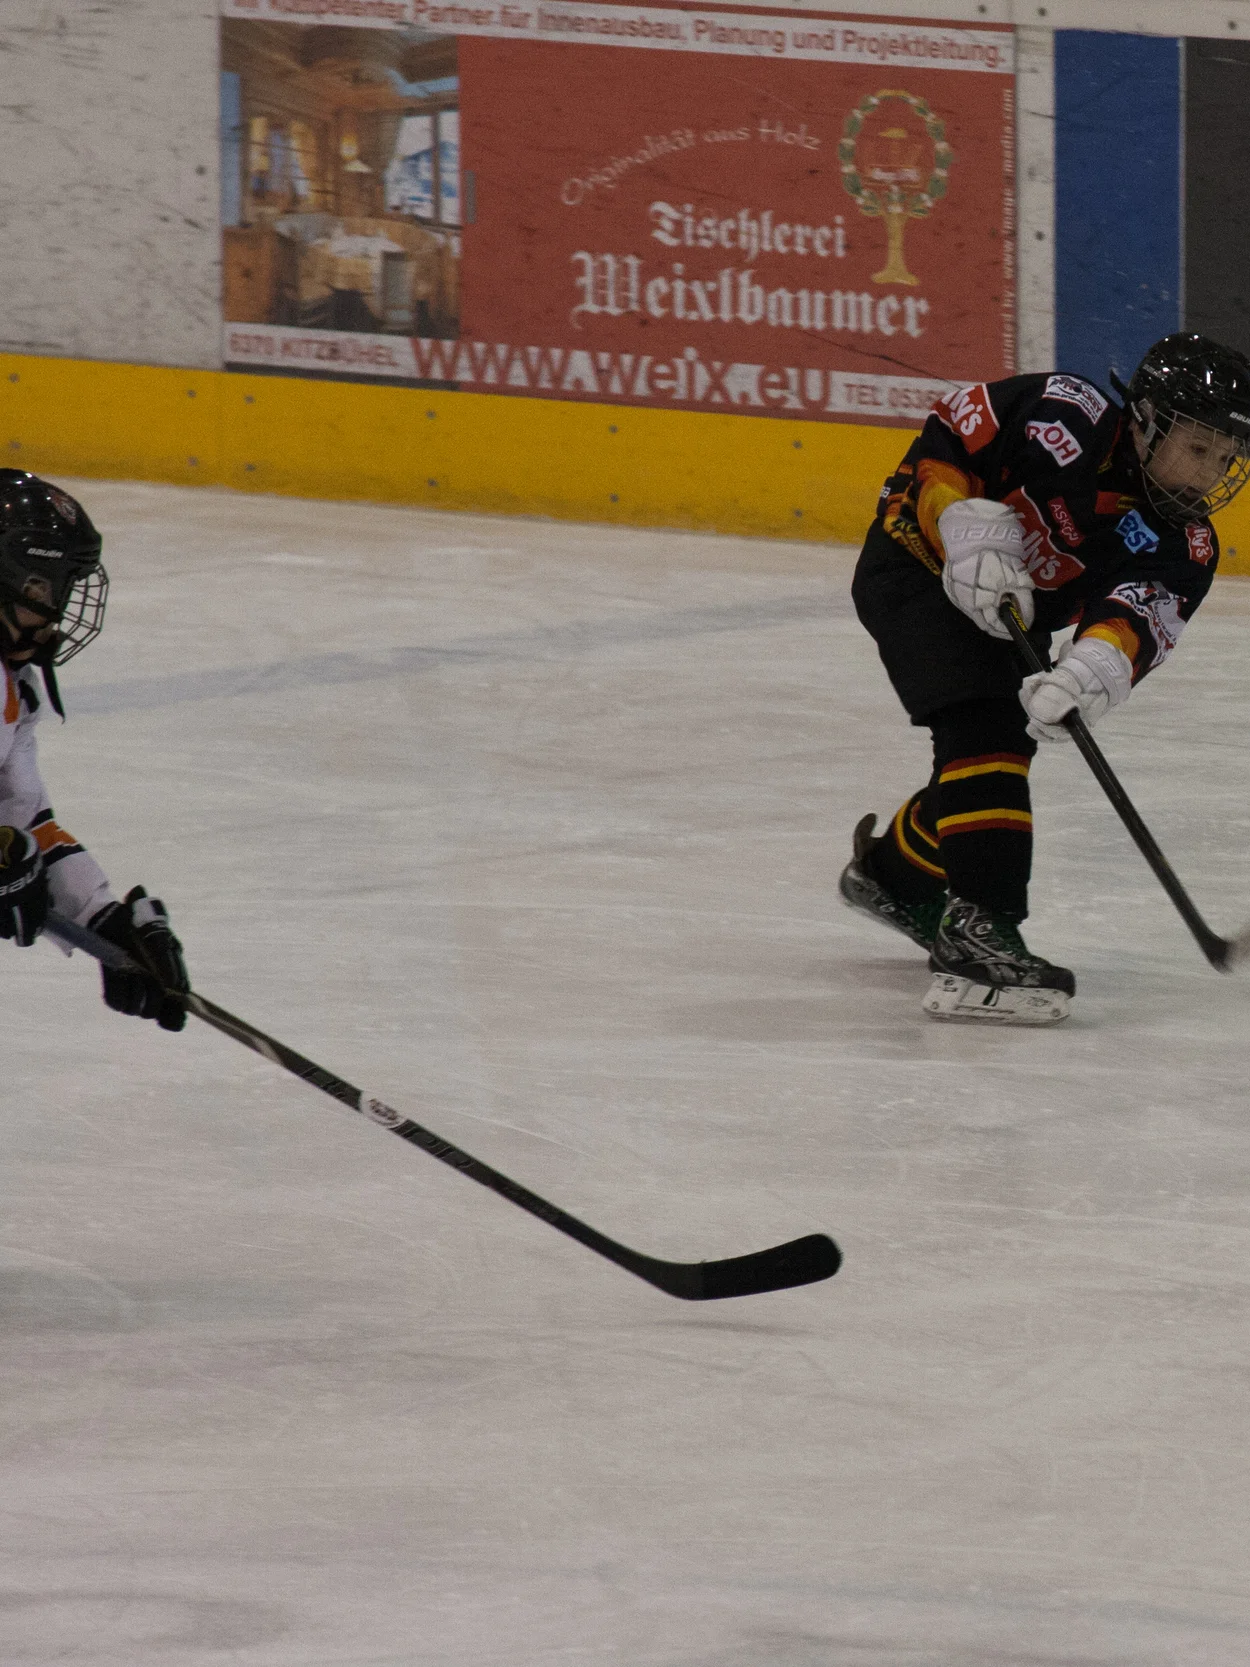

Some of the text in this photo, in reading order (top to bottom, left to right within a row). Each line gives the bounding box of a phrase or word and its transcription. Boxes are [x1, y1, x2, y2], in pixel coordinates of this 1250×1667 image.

[694, 20, 786, 53] Planung
[793, 30, 836, 51] und
[651, 201, 846, 262] Tischlerei
[570, 250, 930, 338] Weixlbaumer
